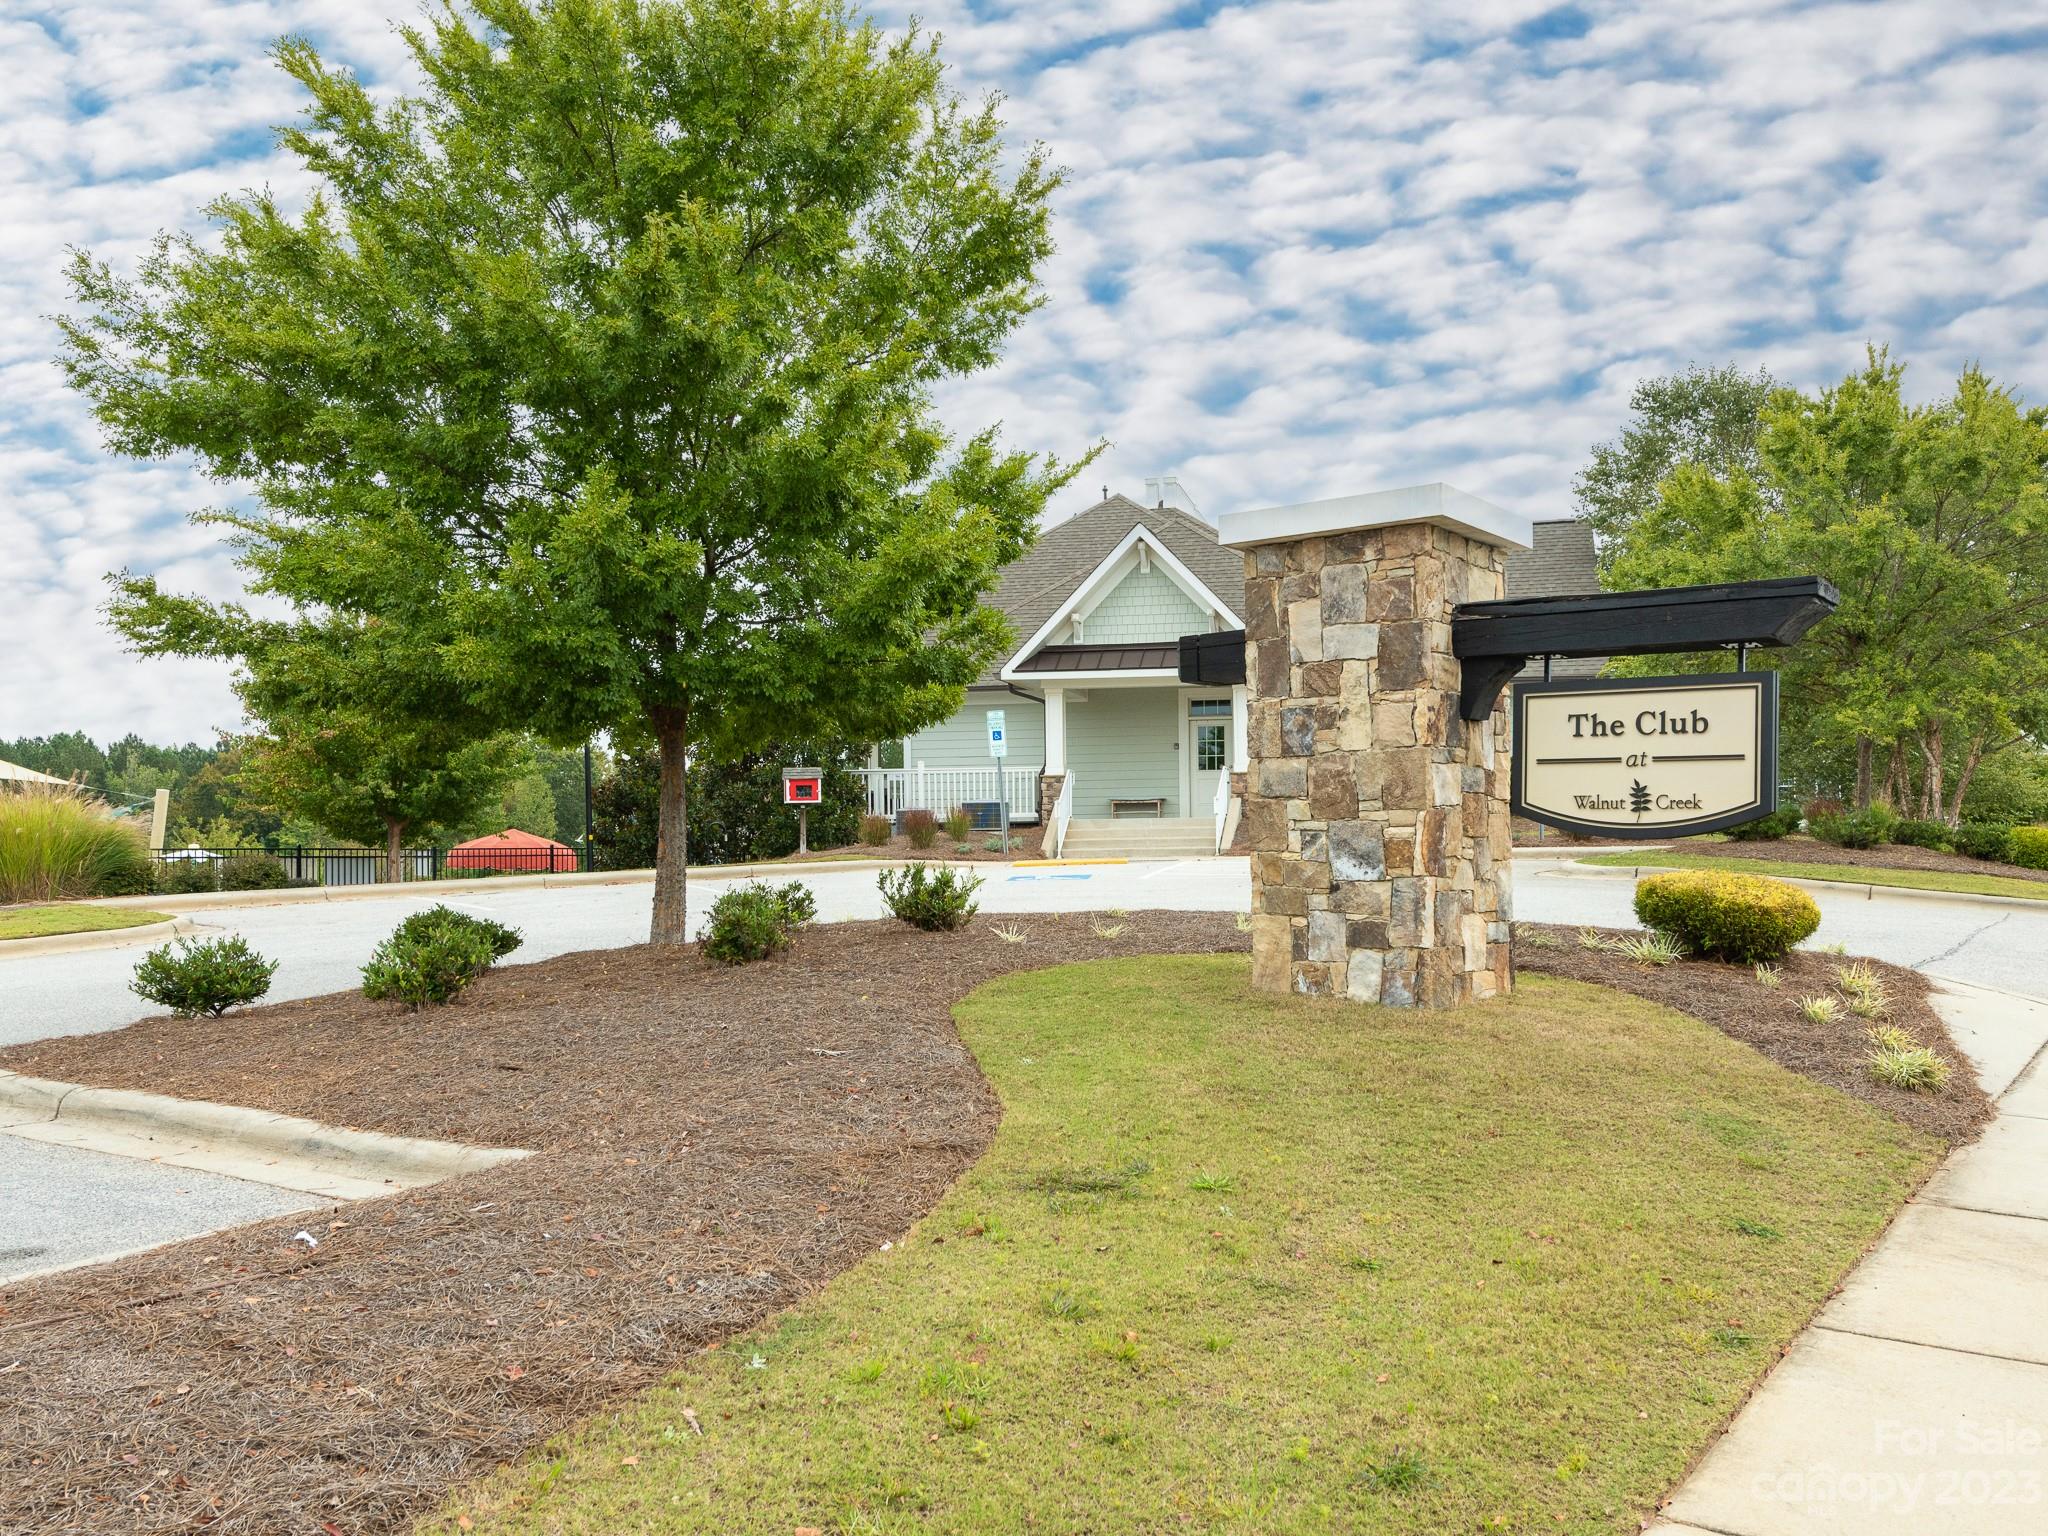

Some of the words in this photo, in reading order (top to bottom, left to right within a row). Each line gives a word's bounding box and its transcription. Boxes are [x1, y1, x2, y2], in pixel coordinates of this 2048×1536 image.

[1568, 713, 1625, 737] The
[1635, 709, 1709, 735] Club
[1626, 752, 1647, 768] at
[1574, 794, 1627, 810] Walnut
[1656, 793, 1702, 810] Creek
